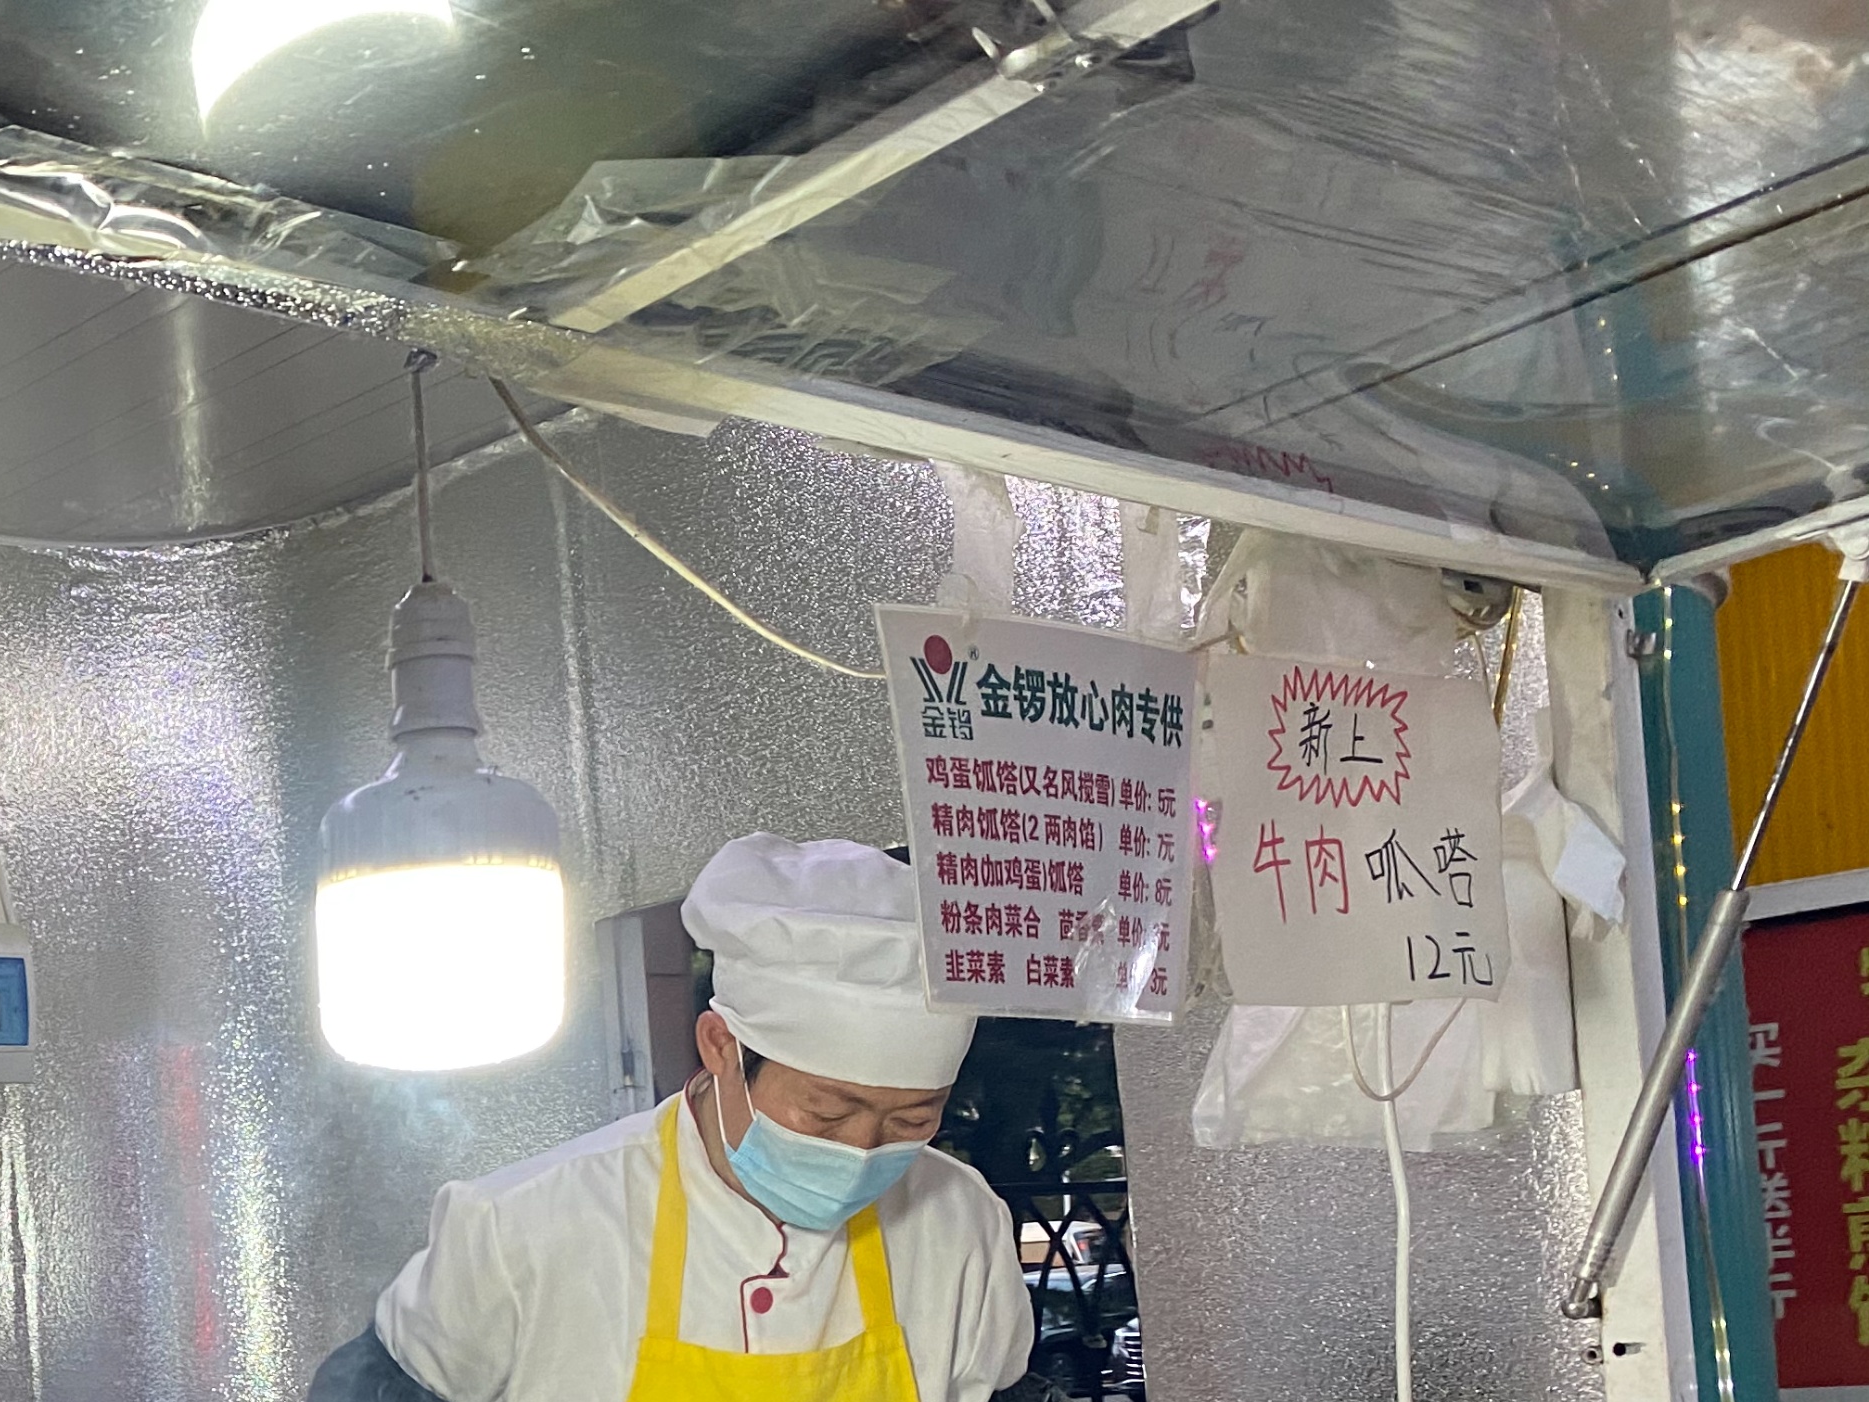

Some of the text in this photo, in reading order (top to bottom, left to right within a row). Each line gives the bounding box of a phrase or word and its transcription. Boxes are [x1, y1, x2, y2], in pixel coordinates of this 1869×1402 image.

[975, 663, 1185, 748] 金锣放心肉专供
[1298, 702, 1384, 775] 新上
[940, 900, 1041, 939] 粉条肉菜合
[945, 949, 1006, 985] 韭菜素
[1026, 953, 1076, 989] 白菜素
[1405, 931, 1494, 986] 12元
